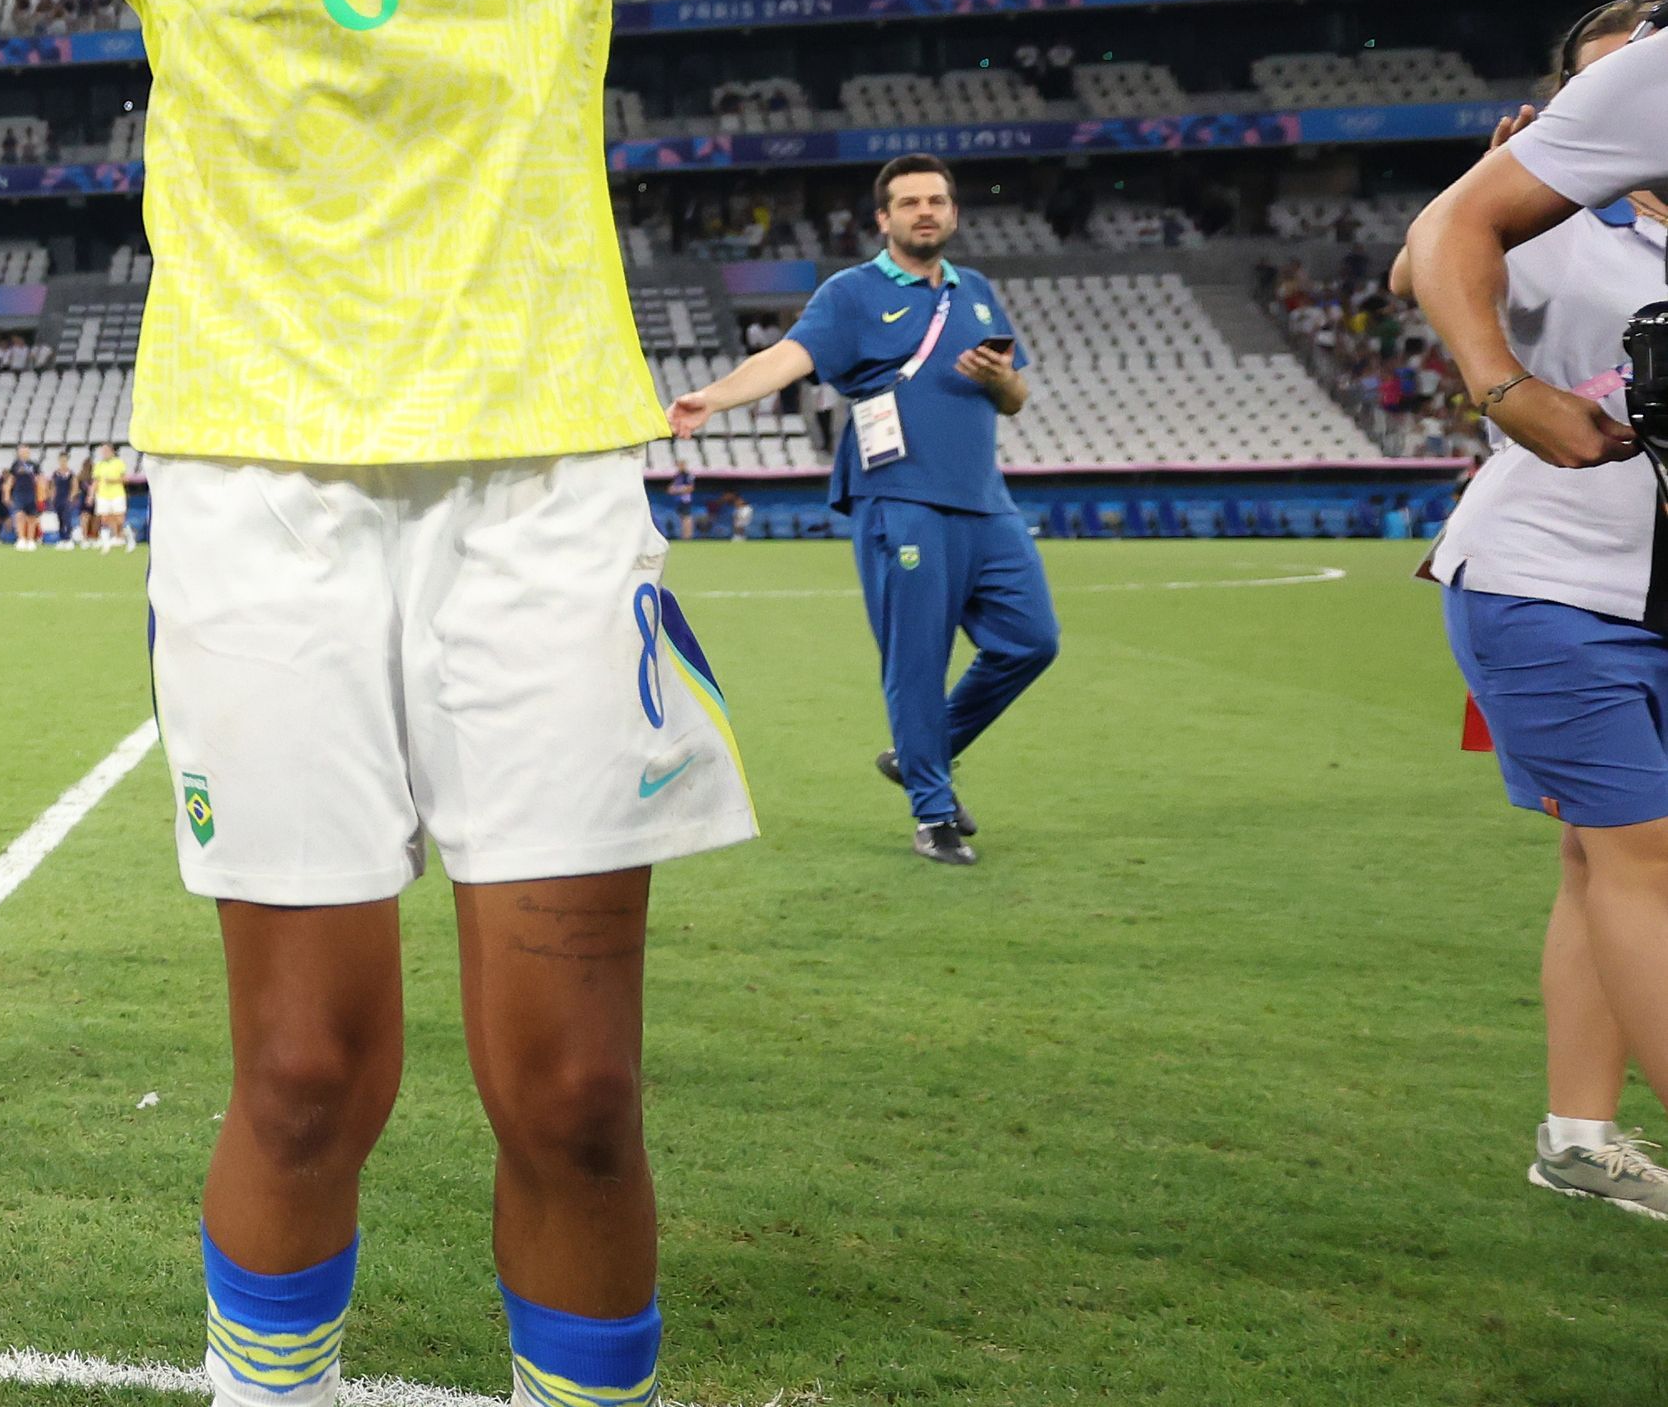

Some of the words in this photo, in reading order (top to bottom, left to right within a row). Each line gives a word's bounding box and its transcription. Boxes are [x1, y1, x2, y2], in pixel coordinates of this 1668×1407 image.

[678, 0, 756, 22] PARIS
[866, 131, 949, 153] PARIS
[956, 127, 1032, 150] 2024
[632, 581, 664, 730] 8
